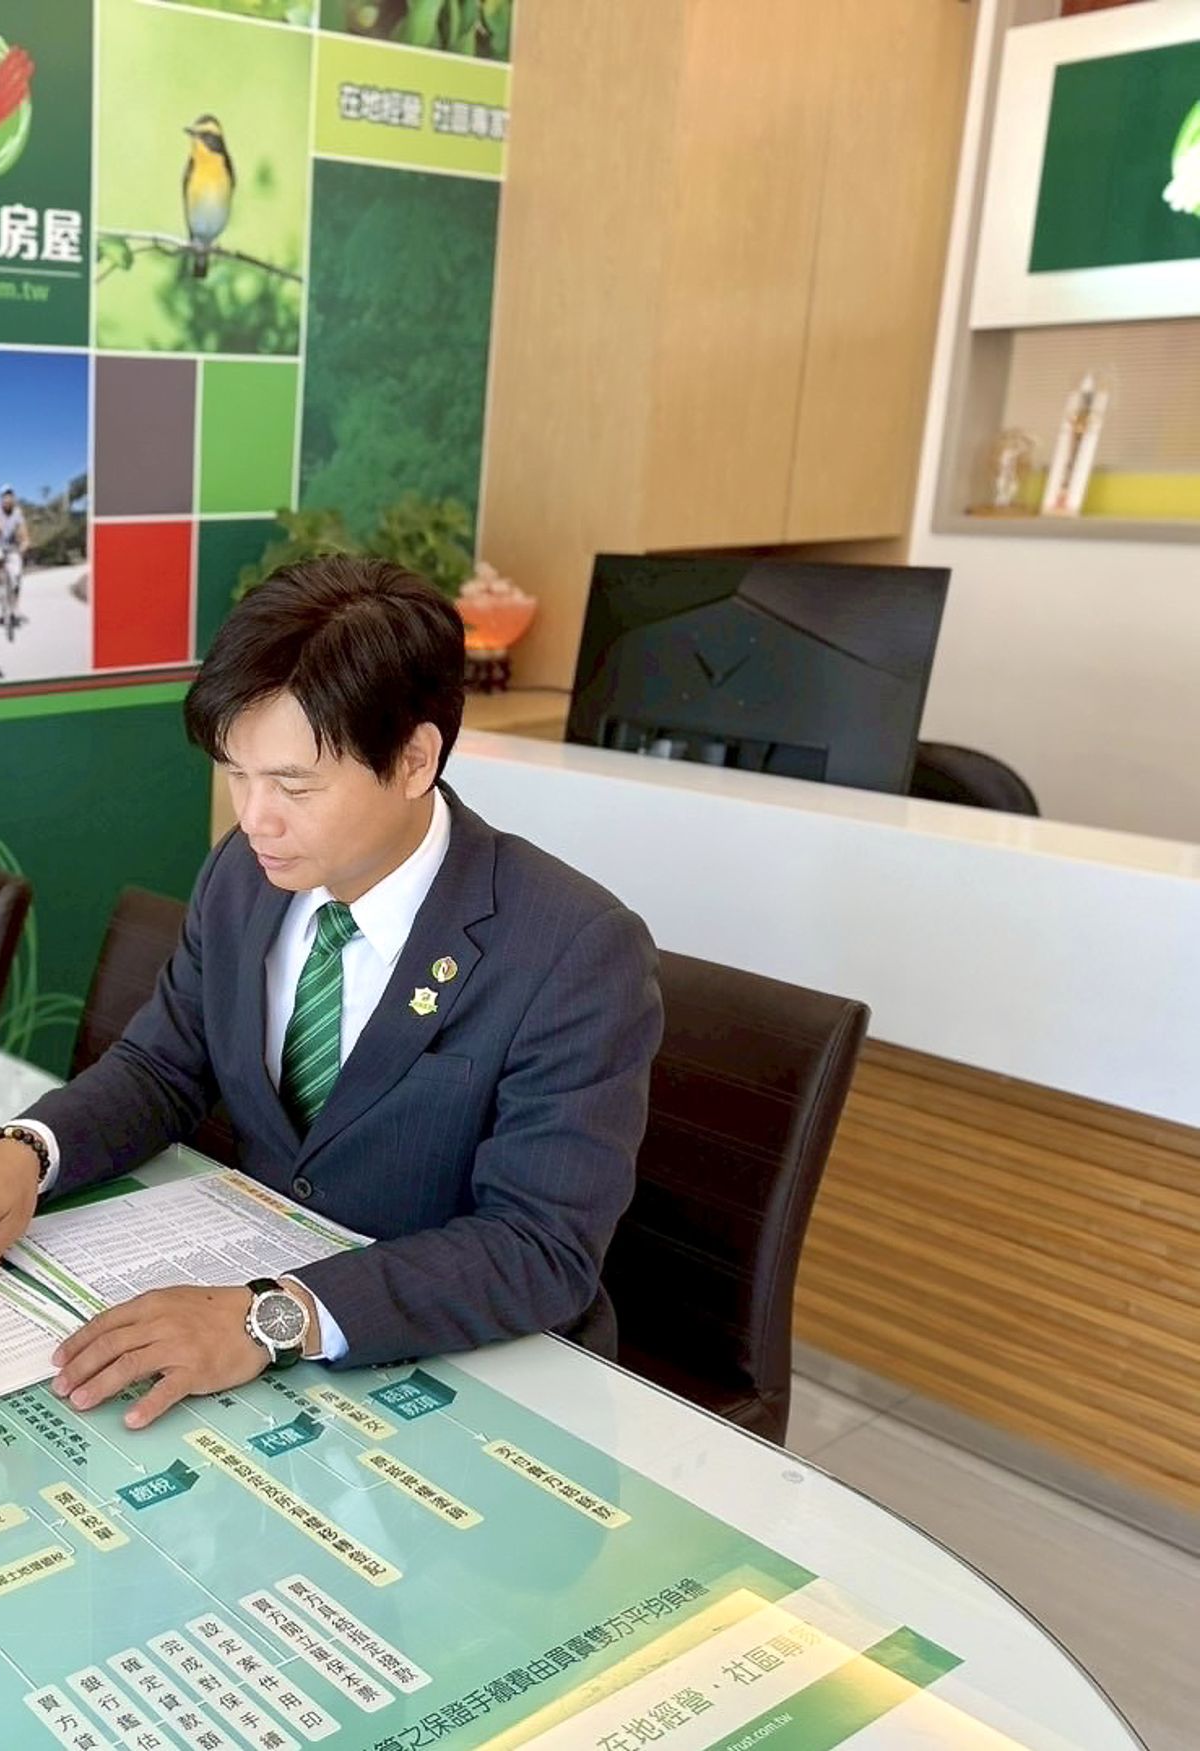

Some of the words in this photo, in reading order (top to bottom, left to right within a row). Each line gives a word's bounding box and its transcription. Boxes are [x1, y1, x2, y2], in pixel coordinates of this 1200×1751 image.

[160, 1639, 286, 1750] 完成對保手續
[198, 1621, 323, 1730] 設定案件用印
